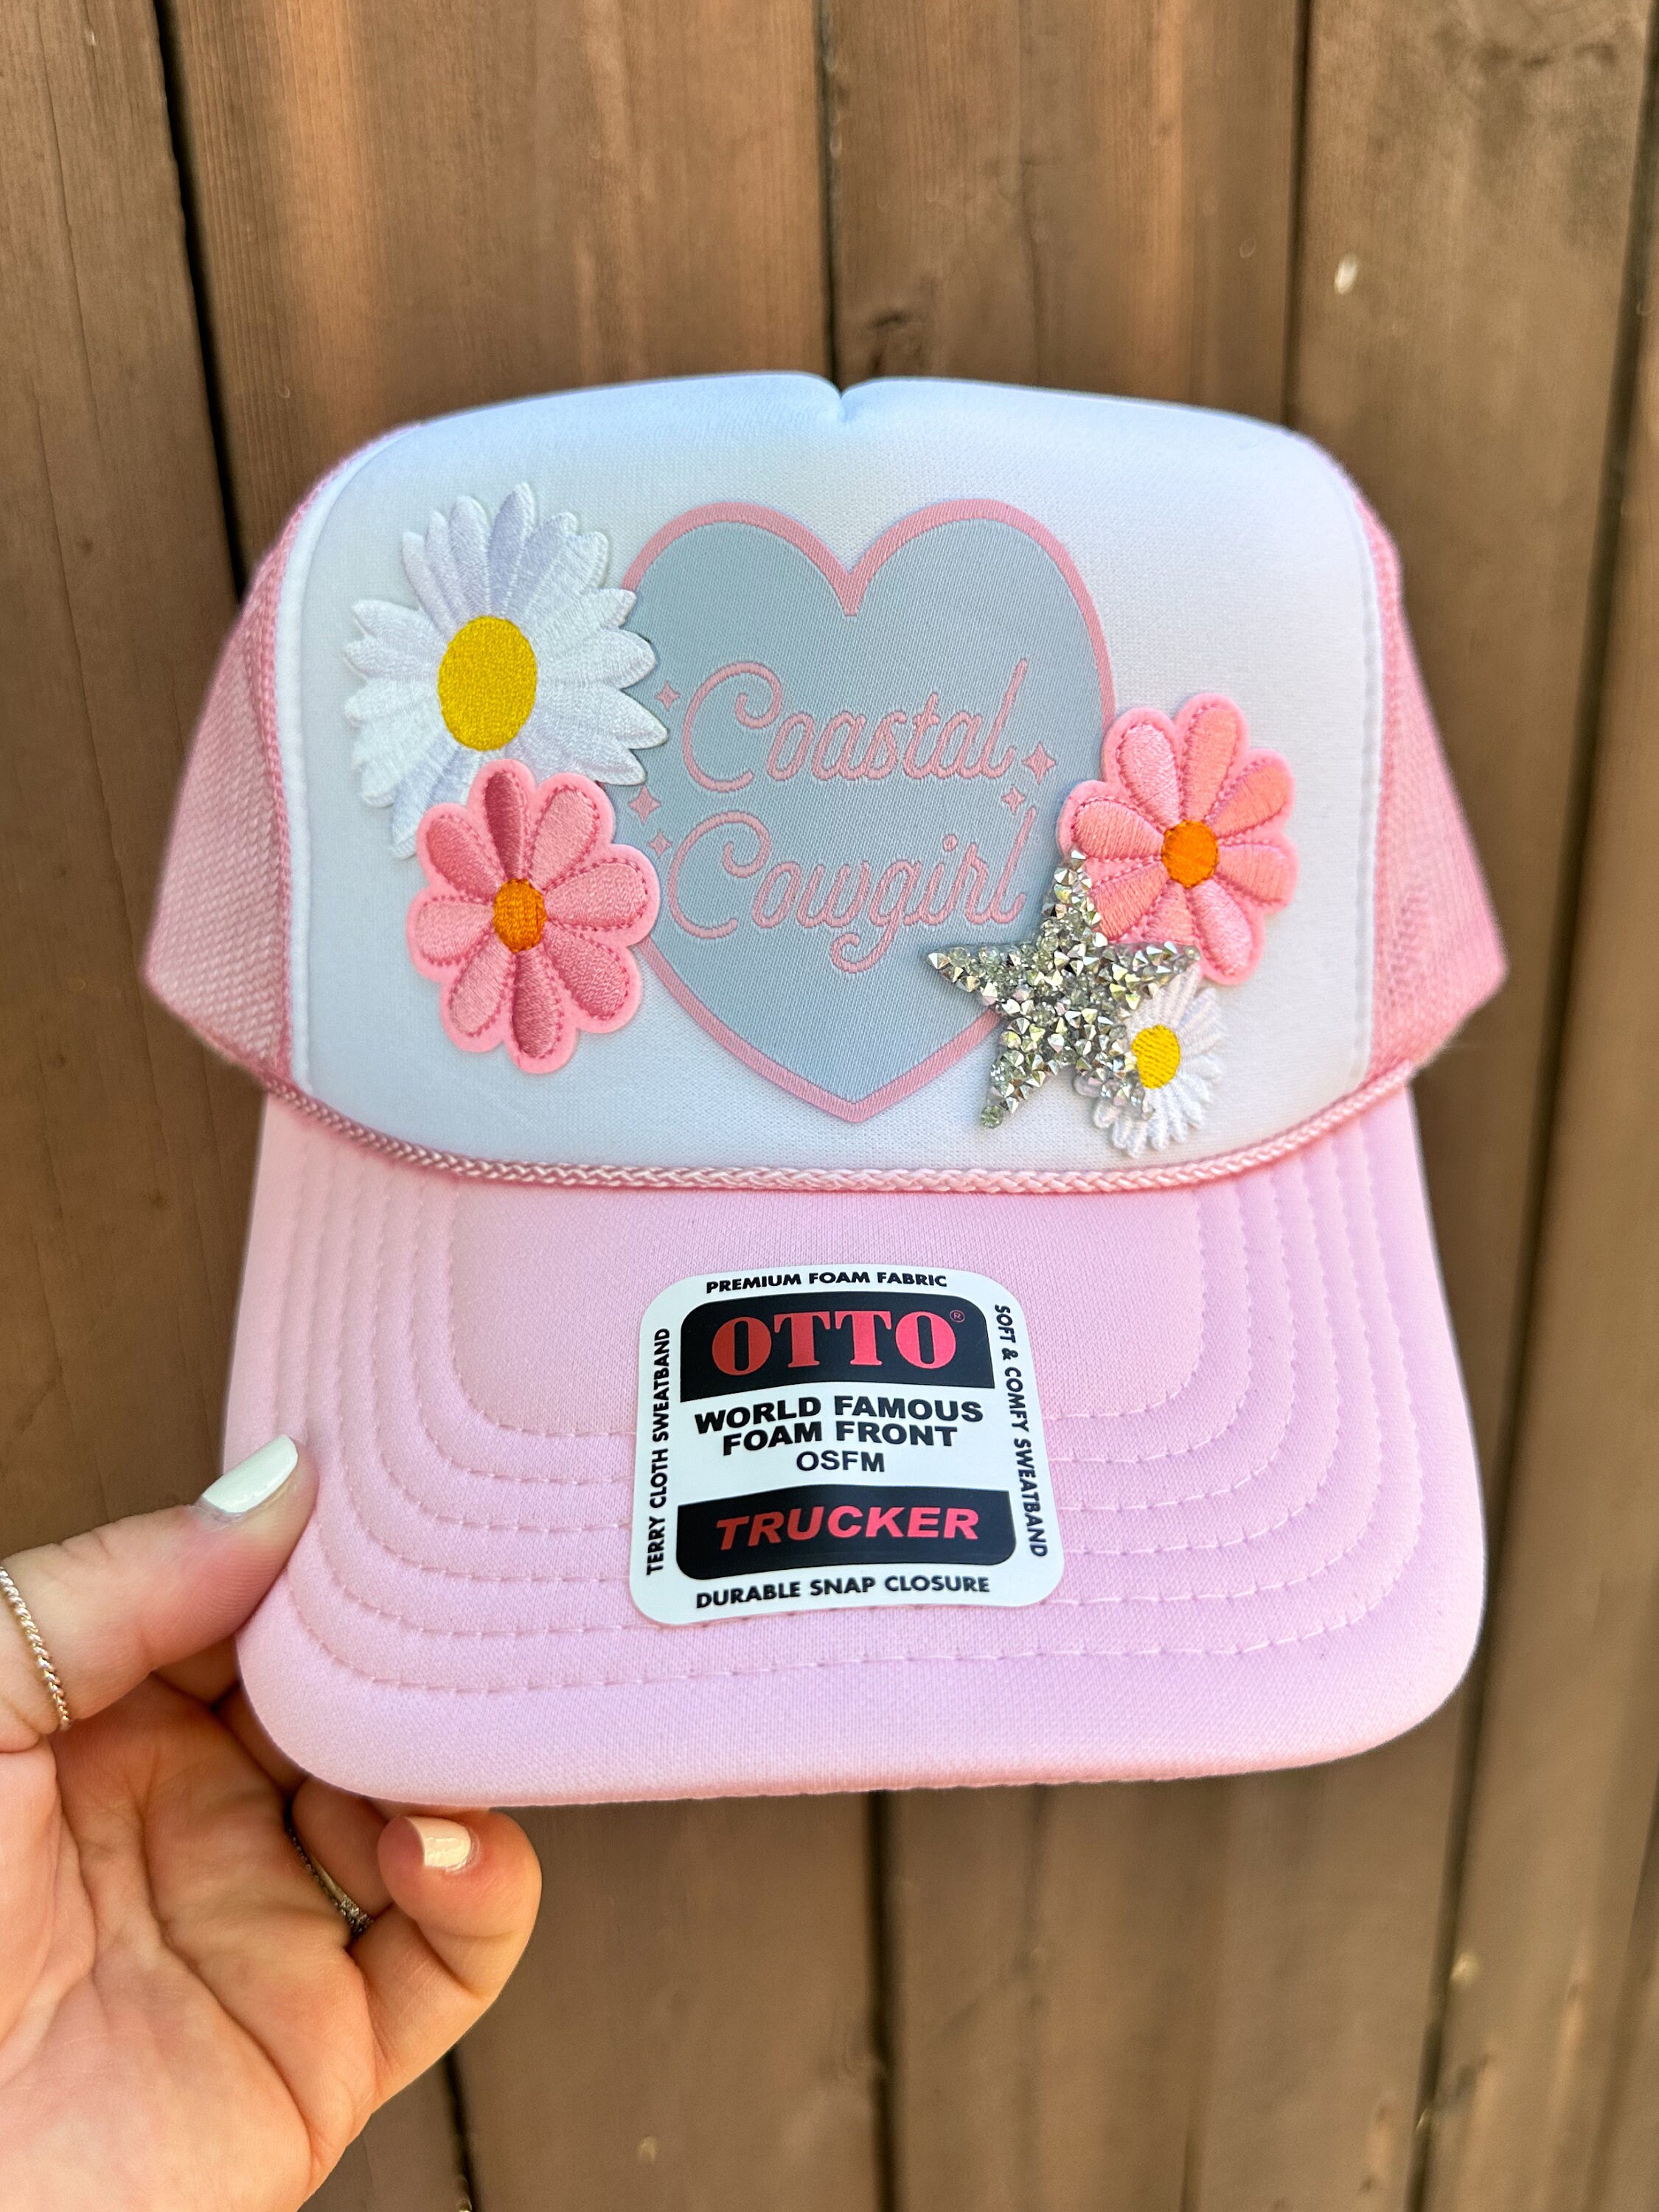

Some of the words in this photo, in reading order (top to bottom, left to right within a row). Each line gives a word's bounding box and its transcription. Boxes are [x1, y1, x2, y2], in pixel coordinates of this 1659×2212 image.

[682, 657, 1029, 793] Coastal
[667, 805, 1037, 974] Cowgirl
[706, 1273, 801, 1294] PREMIUM
[810, 1271, 870, 1284] FOAM
[877, 1272, 947, 1287] FABRIC
[995, 1304, 1016, 1341] SOFT
[1001, 1348, 1019, 1360] &
[652, 1328, 670, 1441] SWEATBAND
[1004, 1367, 1030, 1433] COMFY
[695, 1397, 821, 1434] WORLD
[834, 1395, 984, 1422] FAMOUS
[723, 1422, 823, 1455] FOAM
[835, 1422, 958, 1447] FRONT
[649, 1448, 668, 1508] CLOTH
[796, 1450, 885, 1473] OSFM
[1015, 1438, 1048, 1557] SWEATBAND
[646, 1515, 667, 1576] TERRY
[715, 1506, 979, 1551] TRUCKER
[696, 1581, 801, 1609] DURABLE
[810, 1576, 876, 1596] SNAP
[885, 1576, 990, 1593] CLOSURE
